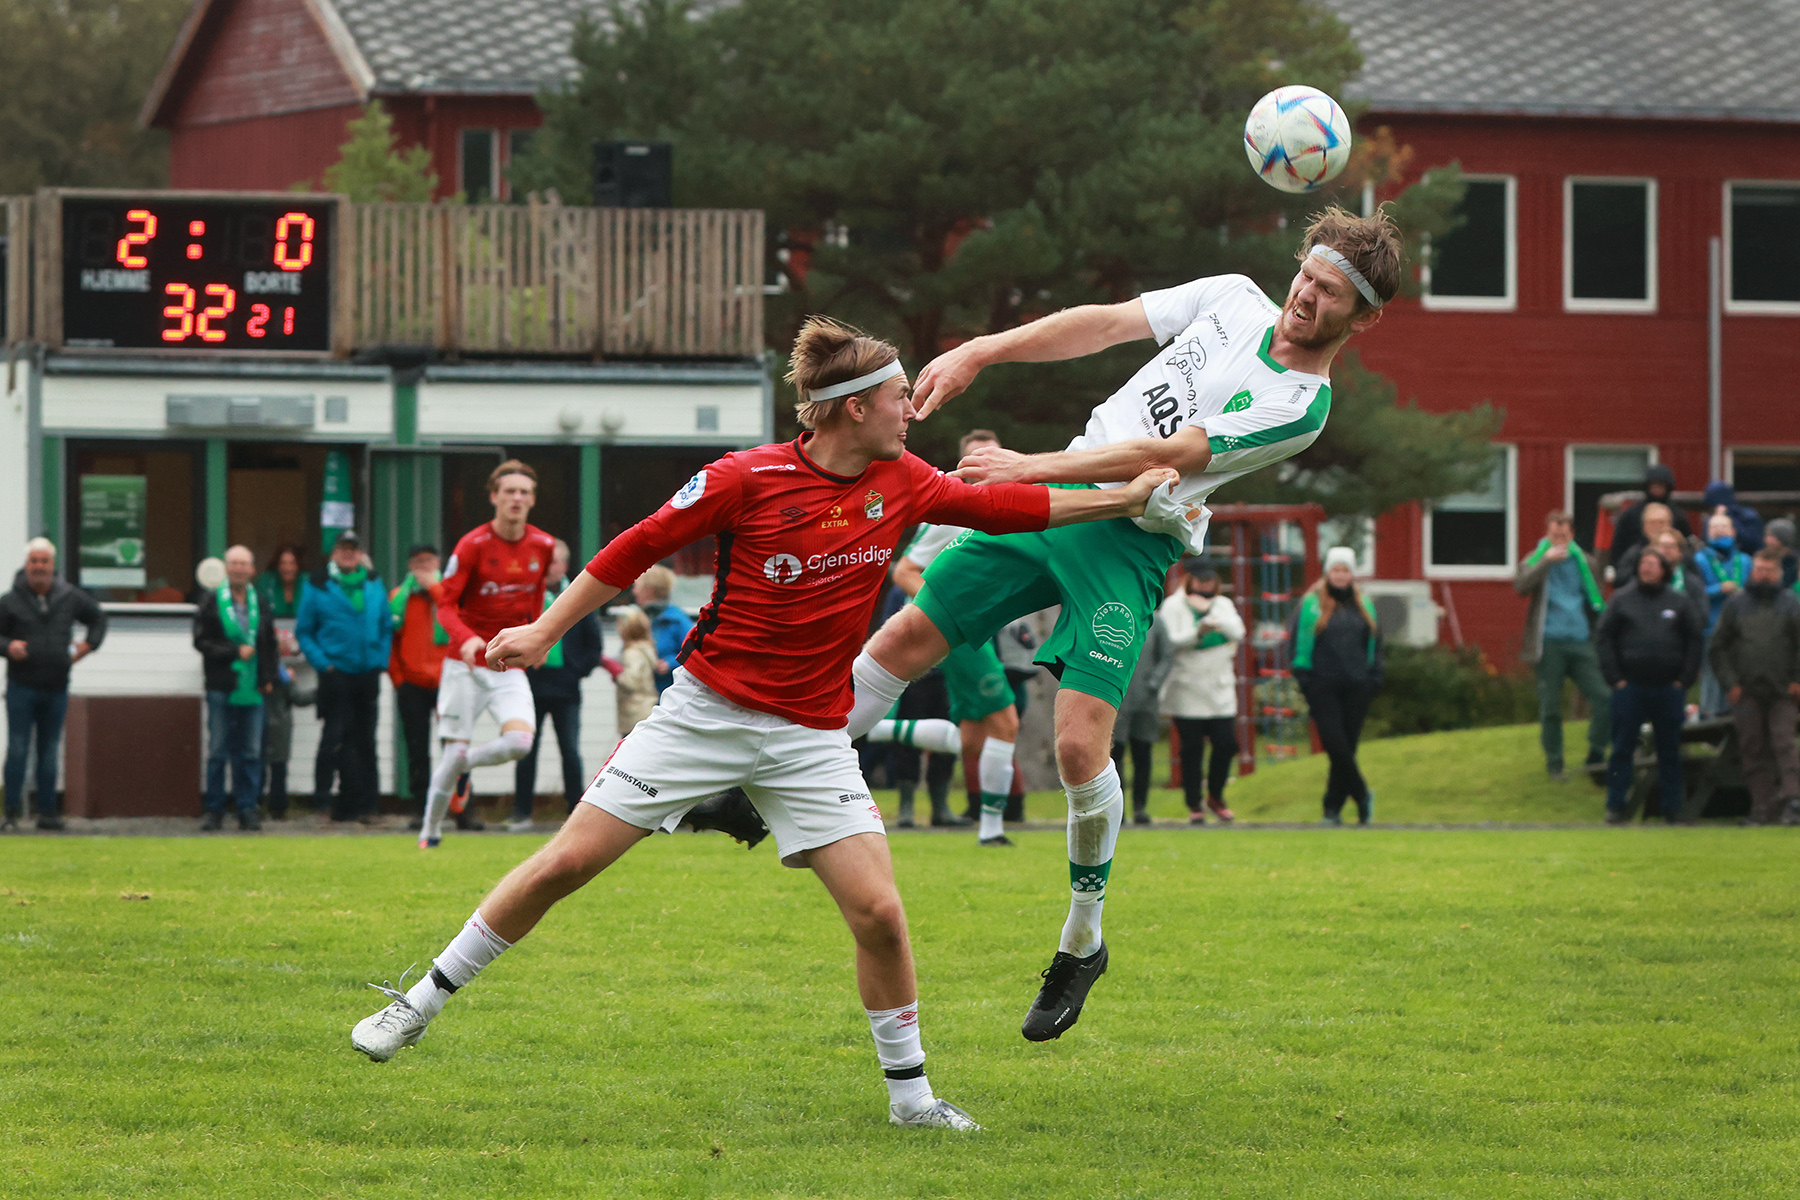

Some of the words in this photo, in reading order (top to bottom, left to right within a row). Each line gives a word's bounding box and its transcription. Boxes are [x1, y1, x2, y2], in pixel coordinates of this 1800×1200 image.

[116, 209, 158, 269] 2
[273, 212, 315, 271] 0
[82, 269, 151, 291] HJEMME
[245, 272, 301, 294] BORTE
[161, 282, 237, 342] 32
[246, 303, 295, 338] 21
[821, 519, 849, 529] EXTRA
[806, 545, 893, 574] Gjensidige
[1089, 650, 1119, 666] CRAFT
[612, 768, 650, 792] BØRSTAD
